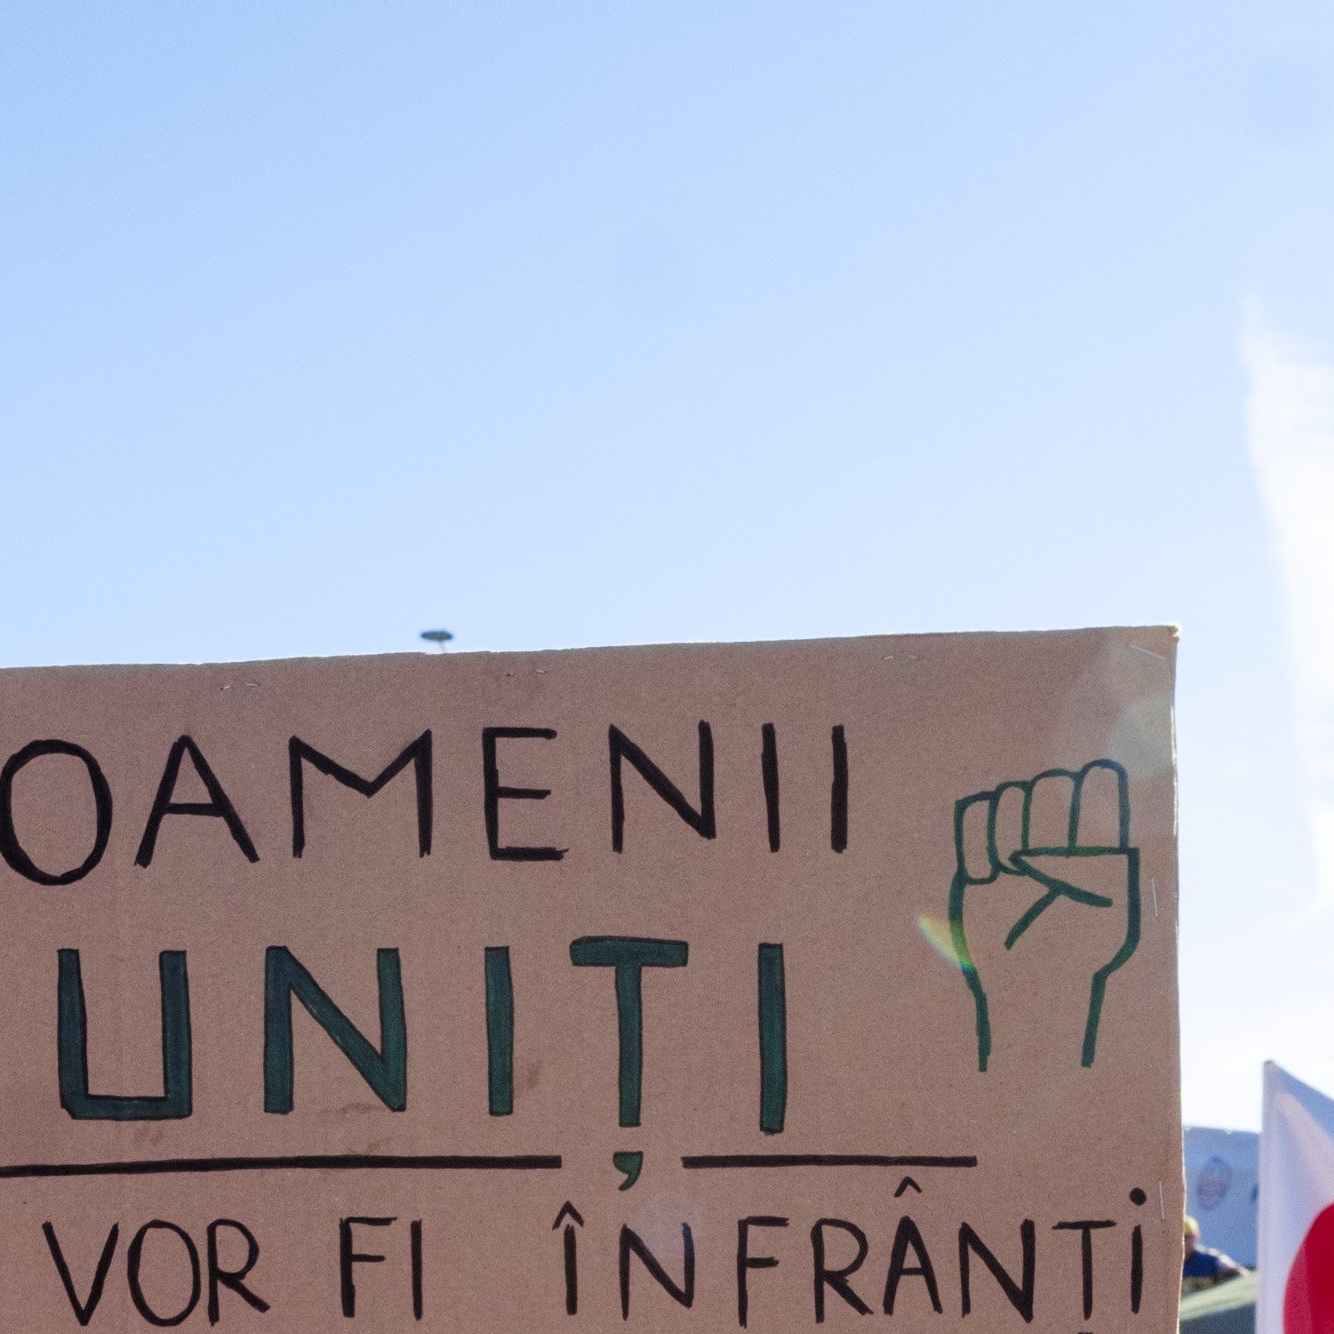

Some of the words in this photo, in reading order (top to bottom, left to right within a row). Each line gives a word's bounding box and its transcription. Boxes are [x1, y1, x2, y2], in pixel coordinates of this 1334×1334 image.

[57, 935, 790, 1193] UNIȚI
[41, 1218, 271, 1327] VOR
[339, 1216, 424, 1321] FI
